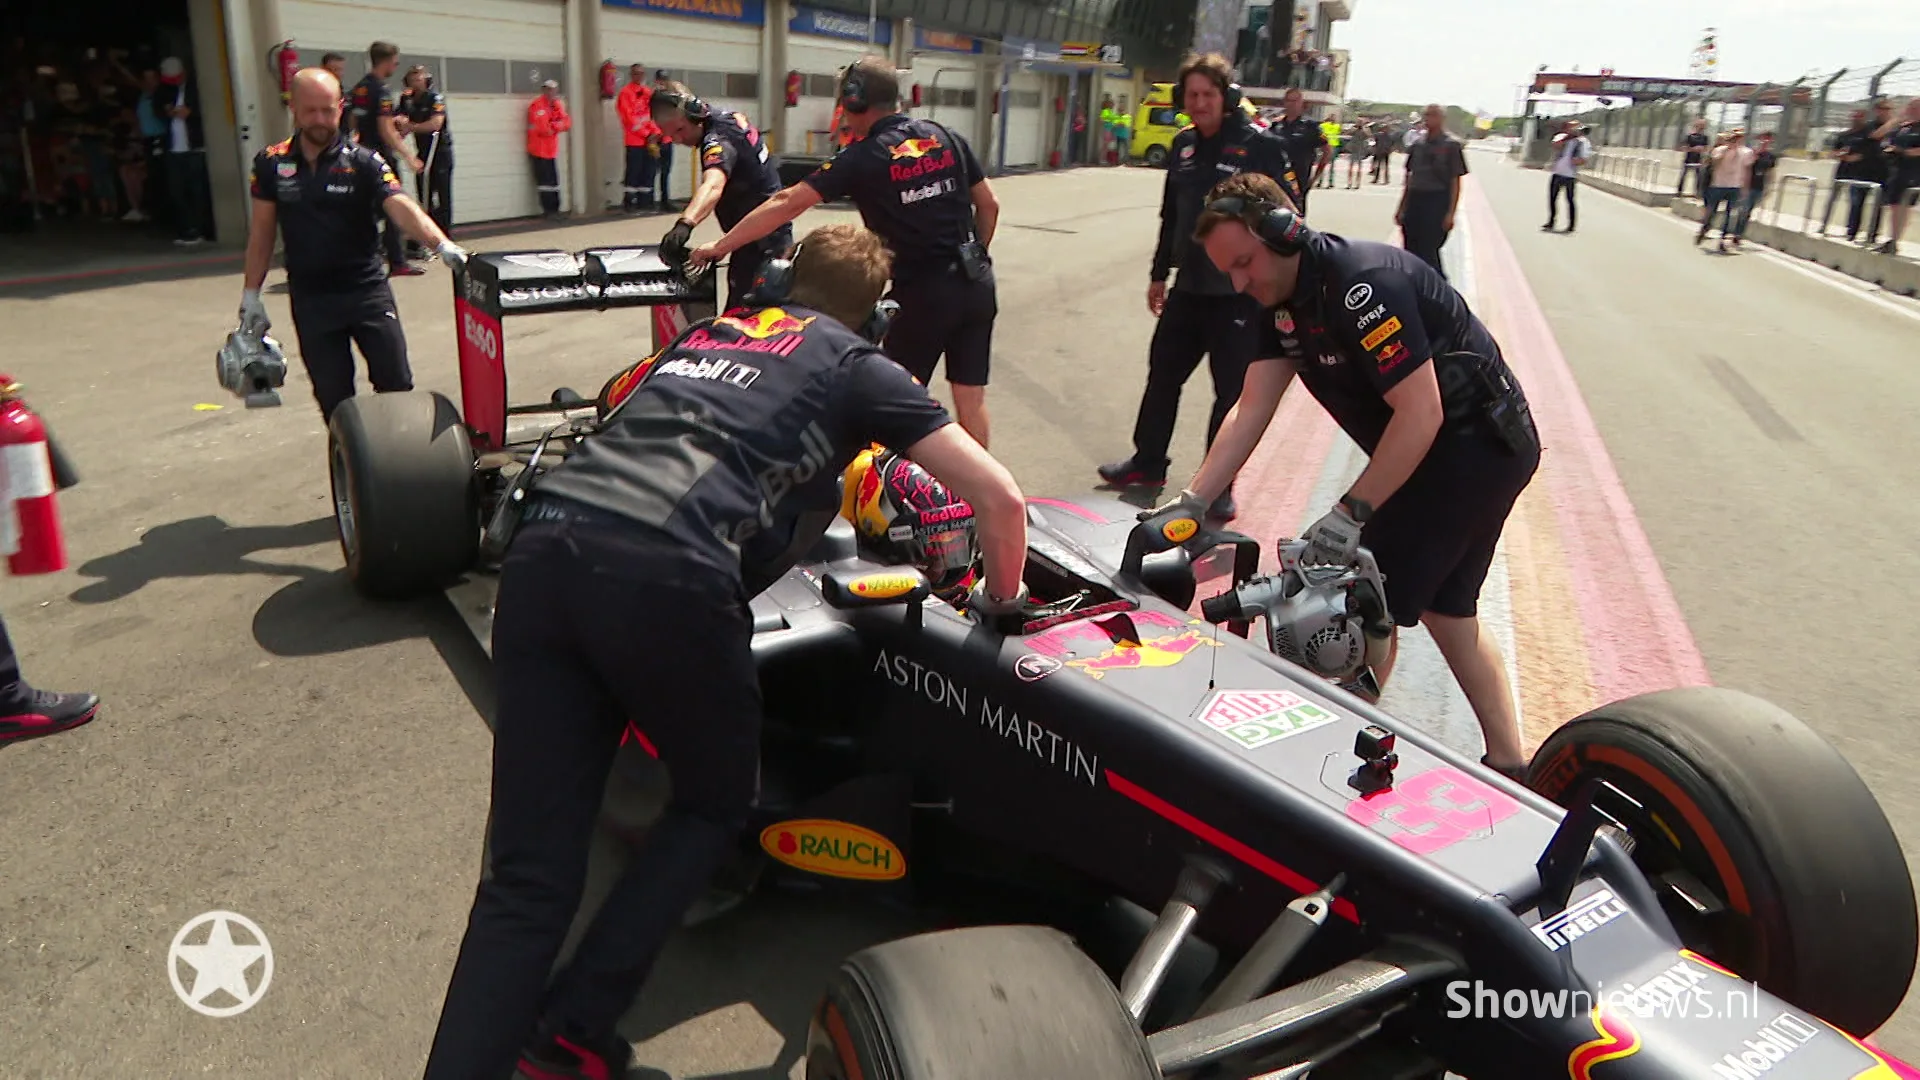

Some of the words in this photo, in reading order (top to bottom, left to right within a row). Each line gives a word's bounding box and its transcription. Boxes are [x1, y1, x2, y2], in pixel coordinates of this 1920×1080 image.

[873, 648, 968, 716] ASTON
[980, 696, 1098, 787] MARTIN
[800, 833, 891, 871] RAUCH
[1529, 888, 1628, 952] PIRELLI
[1711, 1027, 1800, 1080] Mobil
